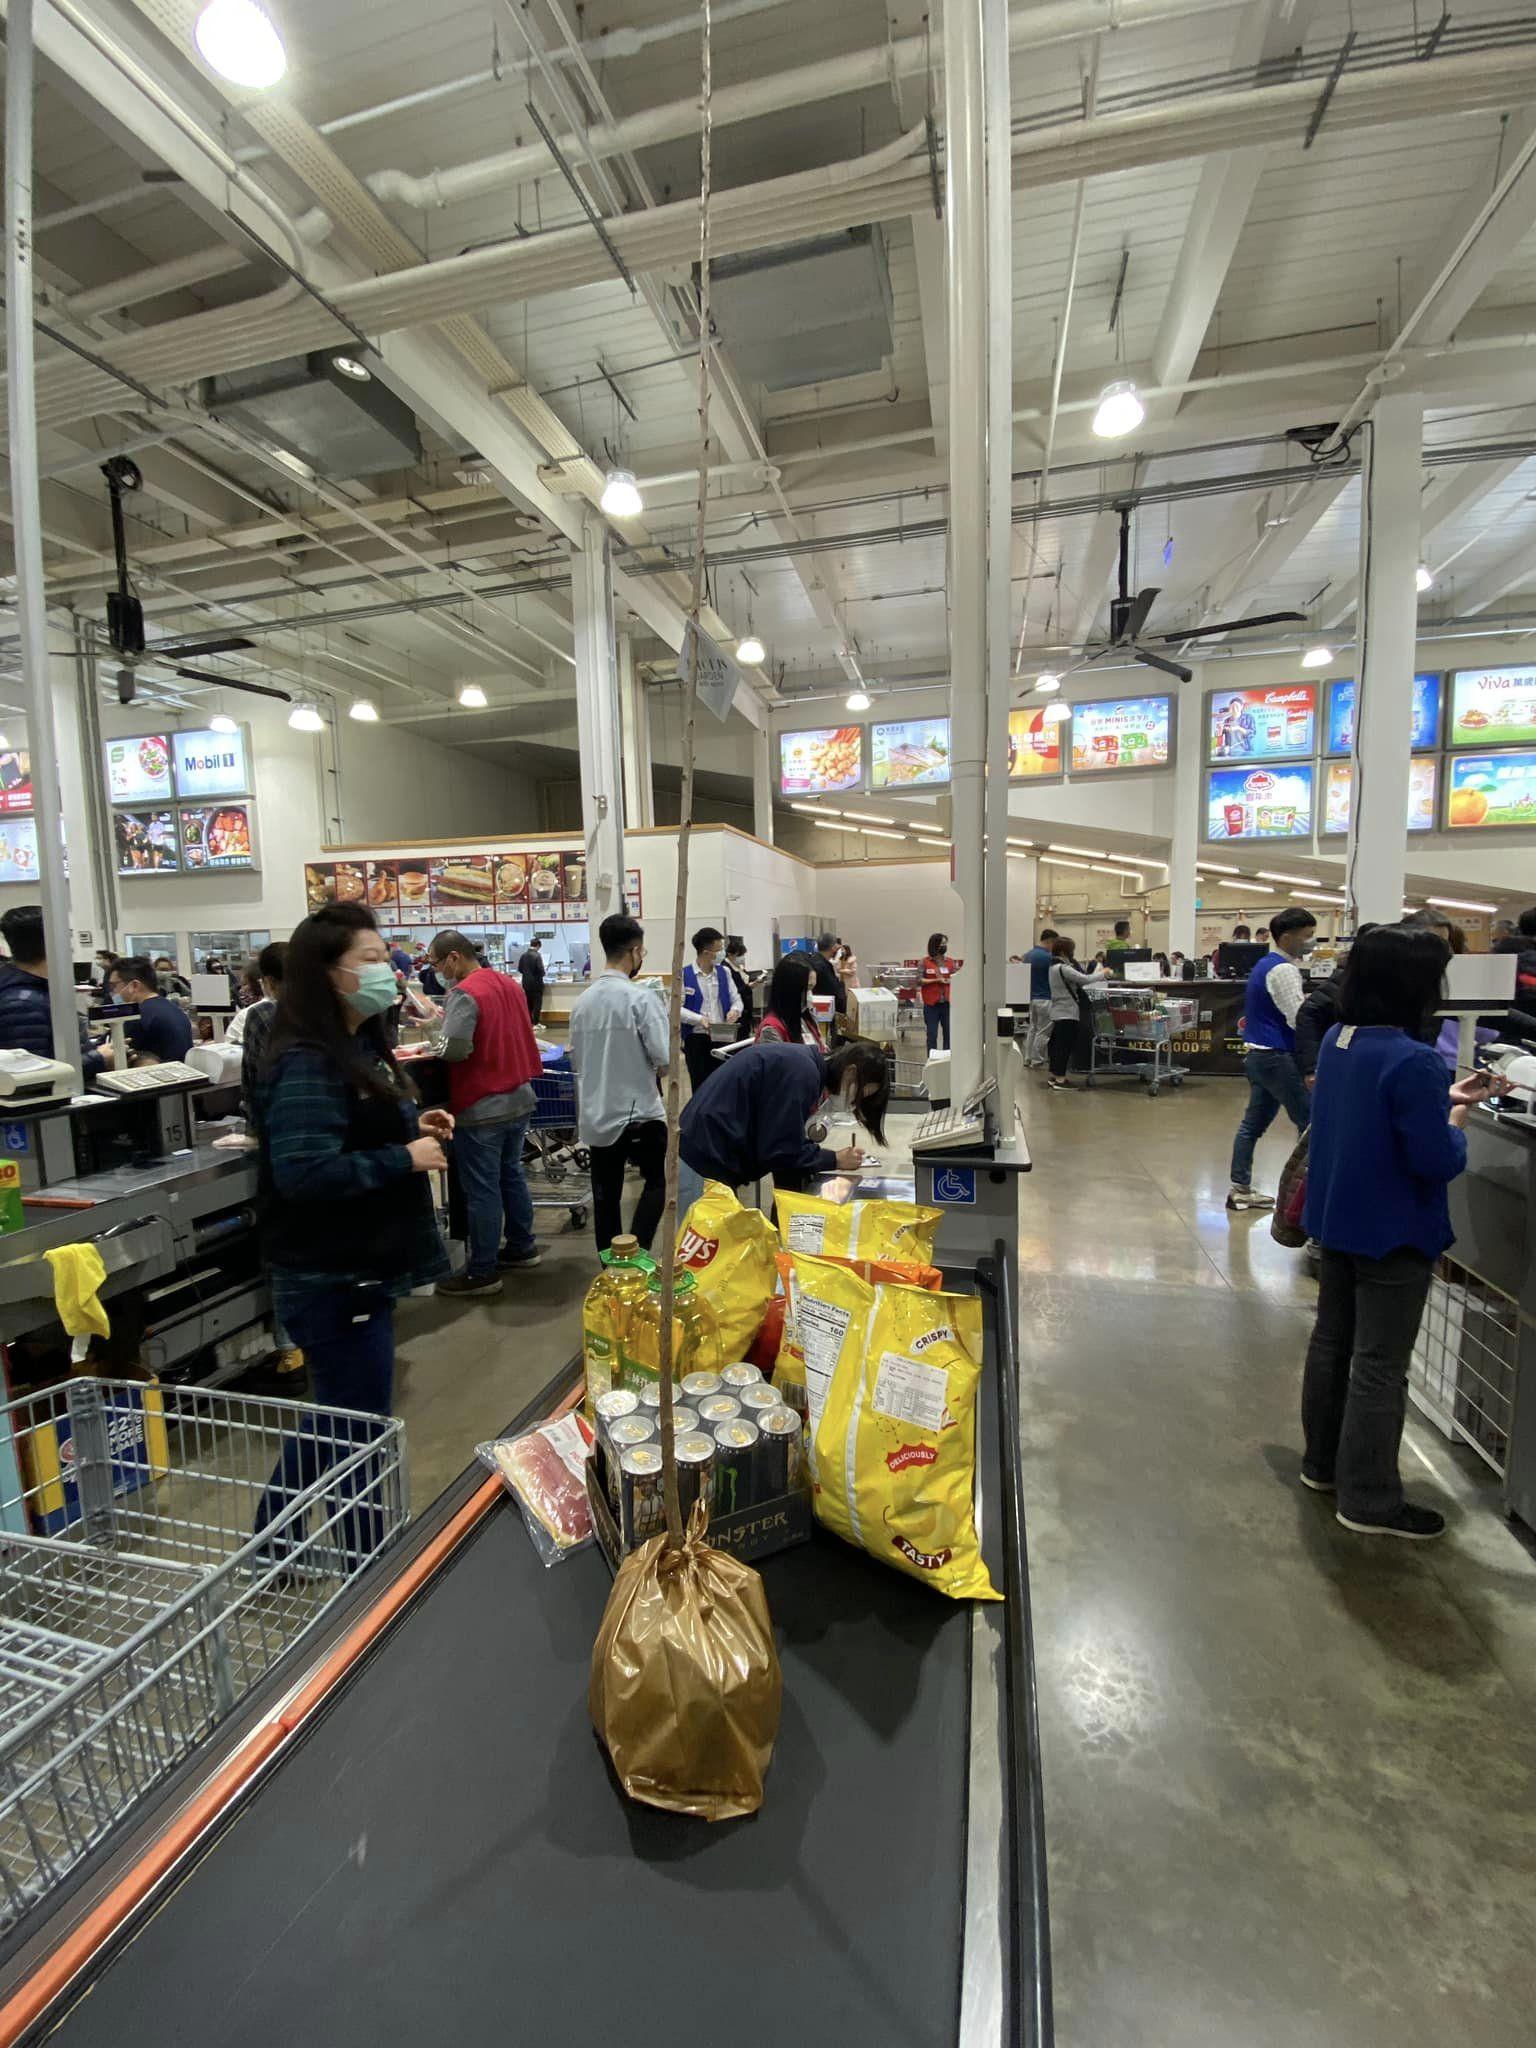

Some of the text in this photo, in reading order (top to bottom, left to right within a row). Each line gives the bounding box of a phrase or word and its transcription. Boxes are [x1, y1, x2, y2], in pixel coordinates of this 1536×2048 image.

[1478, 675, 1511, 690] Viva
[185, 754, 220, 771] Mobil
[167, 1125, 182, 1143] 15
[915, 1330, 948, 1350] CRISPY
[889, 1450, 936, 1469] DELICIOUSLY
[900, 1540, 946, 1568] TASTY
